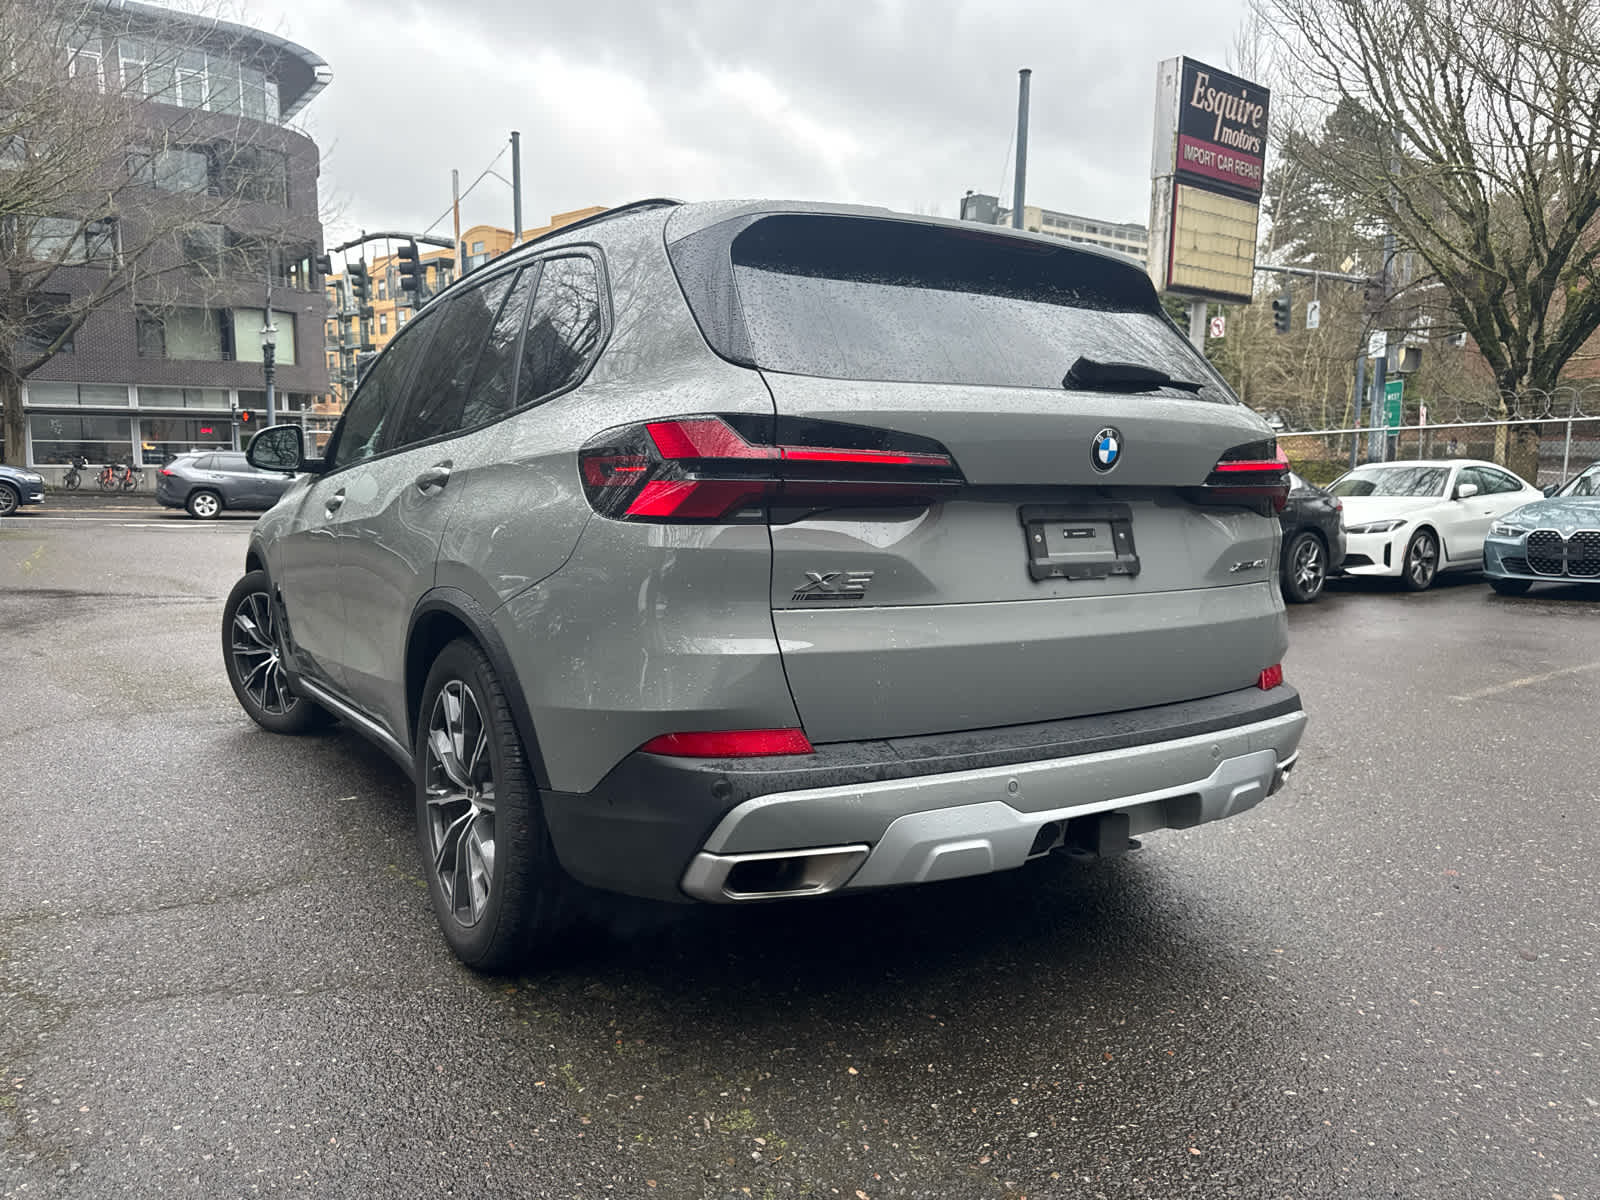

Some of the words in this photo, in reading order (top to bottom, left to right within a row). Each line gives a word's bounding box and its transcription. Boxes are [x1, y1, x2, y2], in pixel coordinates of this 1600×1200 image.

[1190, 71, 1264, 141] Esquire
[1220, 126, 1261, 153] motors
[1183, 143, 1216, 167] IMPORT
[1217, 154, 1234, 173] CAR
[1234, 159, 1261, 180] REPAIR
[793, 571, 875, 592] X5
